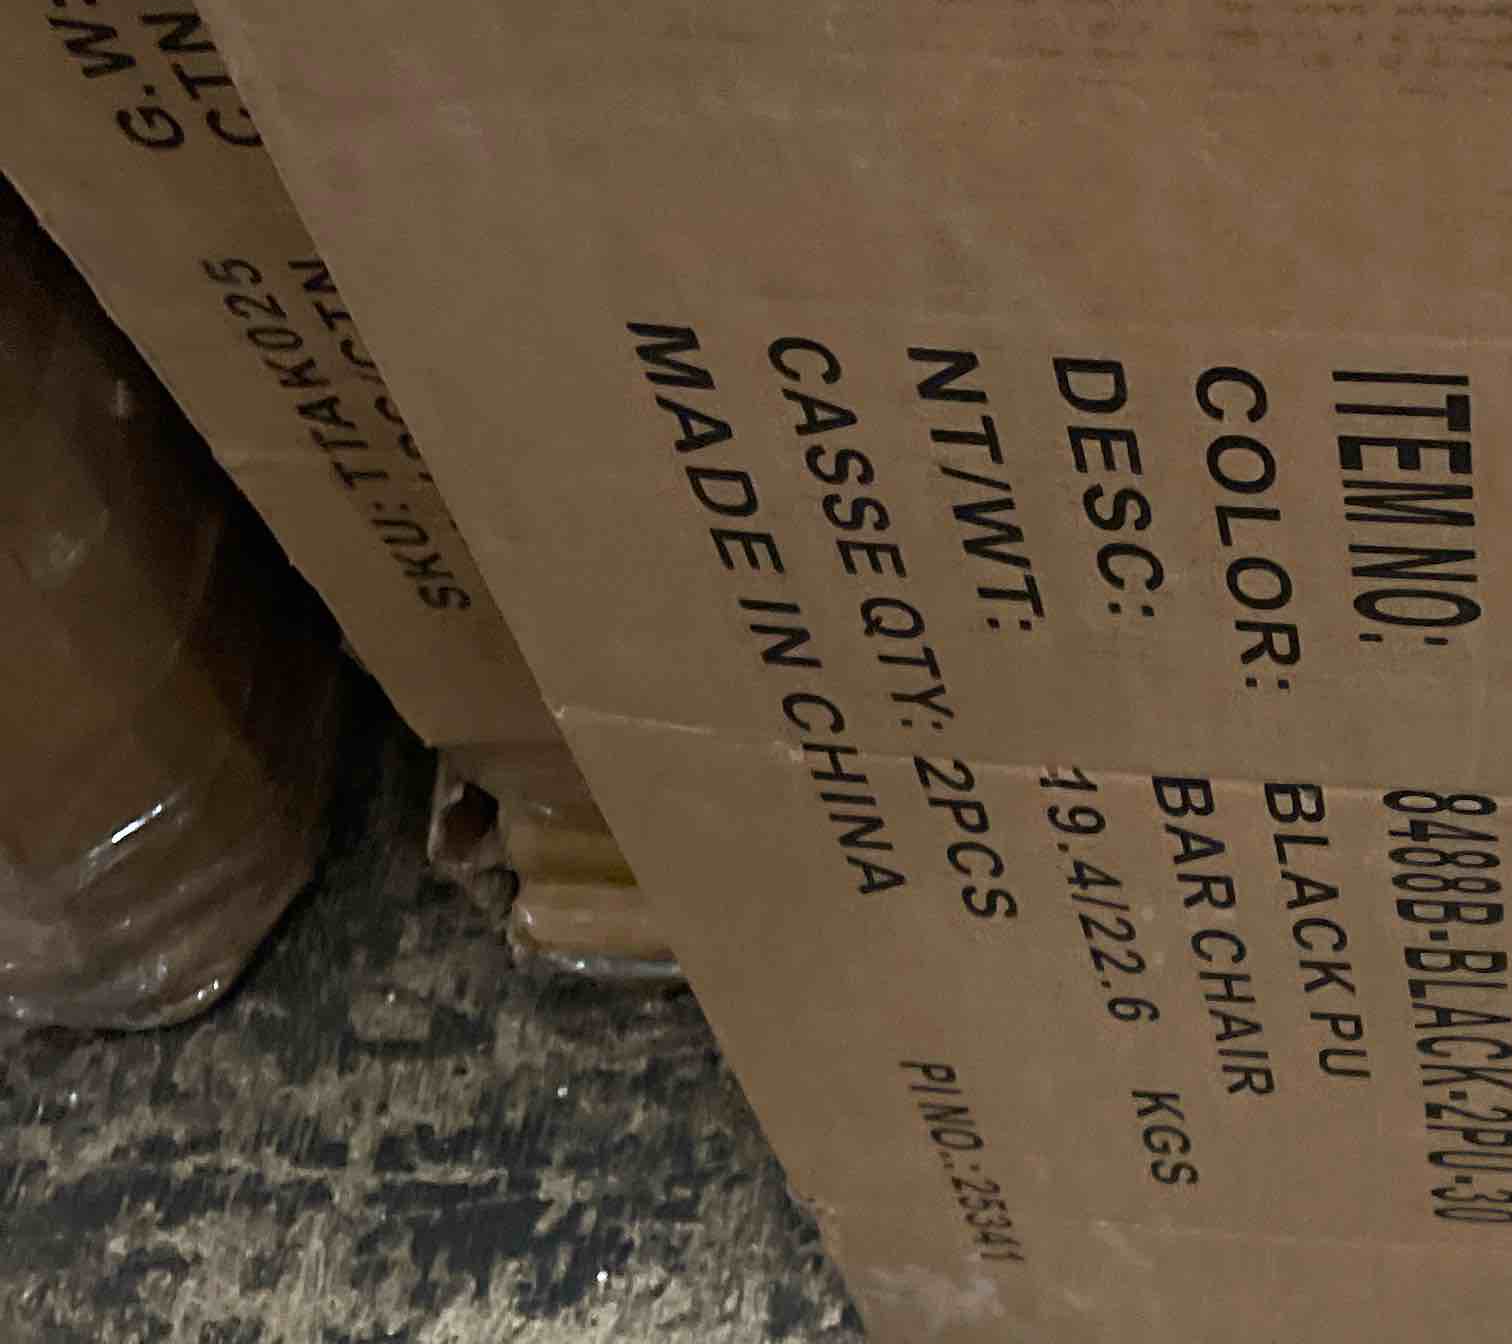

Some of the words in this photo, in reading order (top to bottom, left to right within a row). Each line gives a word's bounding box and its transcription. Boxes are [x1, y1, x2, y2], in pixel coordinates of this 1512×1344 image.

[139, 11, 263, 147] CTN
[1052, 357, 1164, 617] DESC:
[1196, 366, 1301, 689] COLOR:
[1332, 371, 1475, 526] ITEM
[626, 322, 785, 575] MADE
[738, 599, 823, 669] IN
[782, 693, 906, 895] CHINA
[768, 337, 906, 578] CASSE
[860, 596, 955, 730] QTY:
[913, 756, 1017, 921] 2PCS
[1349, 544, 1481, 645] NO:
[907, 347, 1045, 631] NT/WT:
[1039, 765, 1160, 1024] 19.4/22.6
[1131, 1089, 1198, 1185] KGS
[1152, 775, 1237, 911] BAR
[1264, 781, 1356, 998] BLACK
[1191, 929, 1275, 1097] CHAIR
[1309, 1012, 1371, 1079] PU
